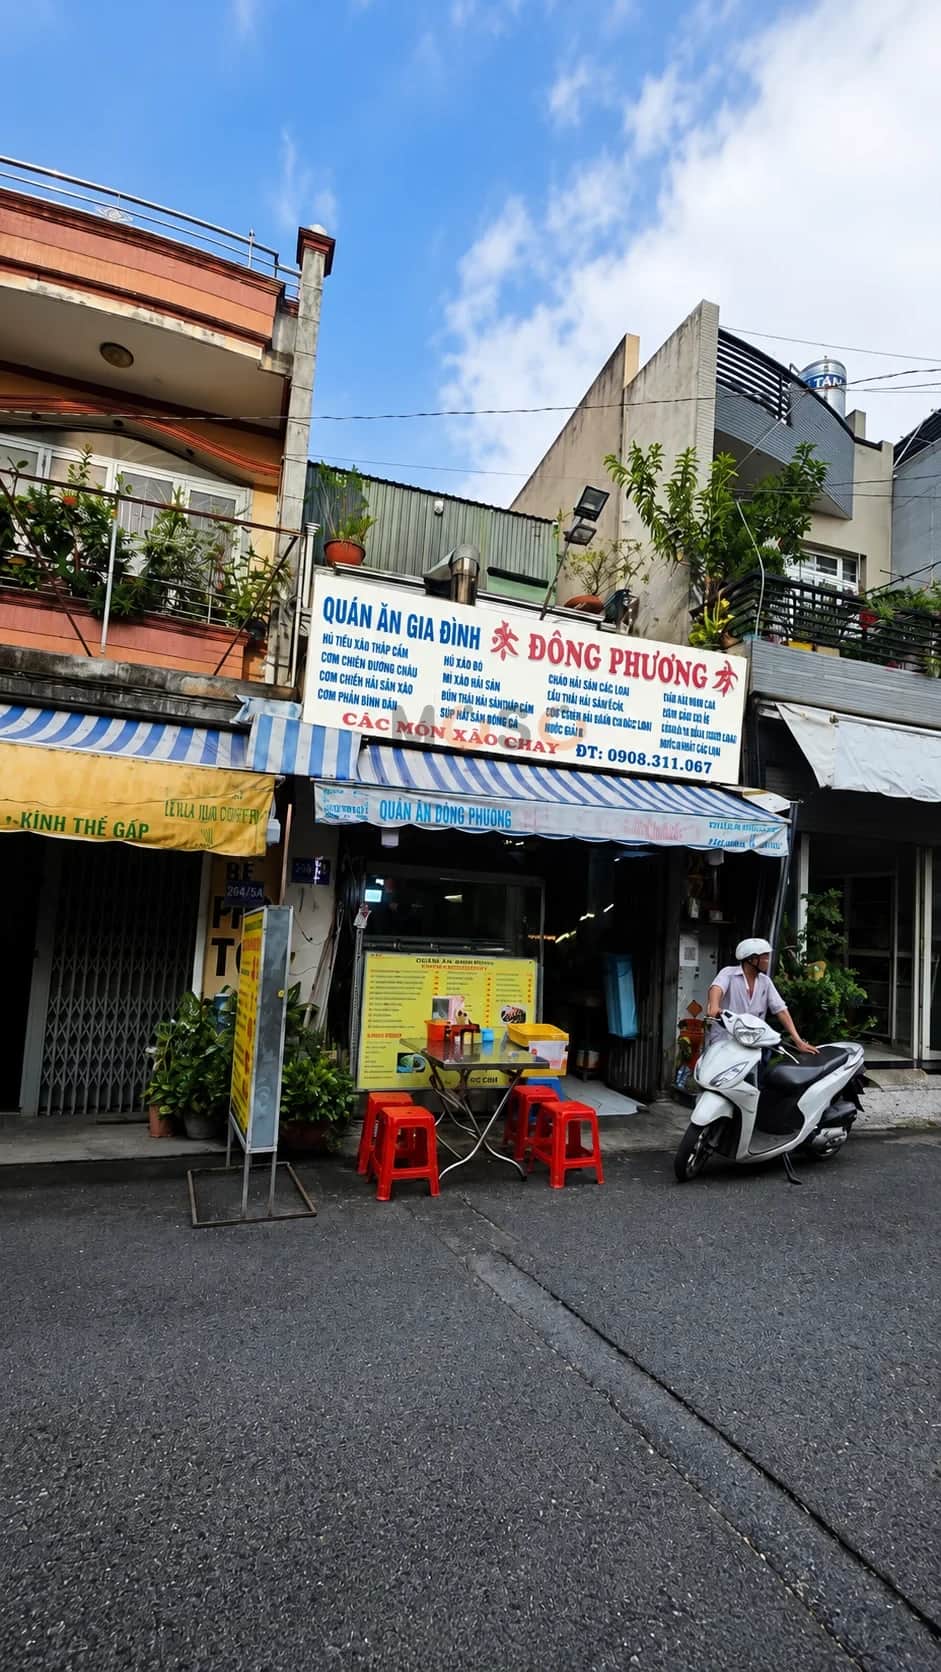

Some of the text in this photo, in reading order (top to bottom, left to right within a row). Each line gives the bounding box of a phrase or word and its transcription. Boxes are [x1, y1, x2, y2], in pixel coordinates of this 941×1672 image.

[322, 596, 480, 650] QUÁN ĂN GIA ĐÌNH
[528, 630, 708, 690] ĐÔNG PHƯƠNG
[504, 736, 560, 755] CHAY
[576, 744, 712, 774] ĐT: 0908.311.067
[20, 810, 66, 832] KÍNH
[379, 798, 412, 821] QUÁN
